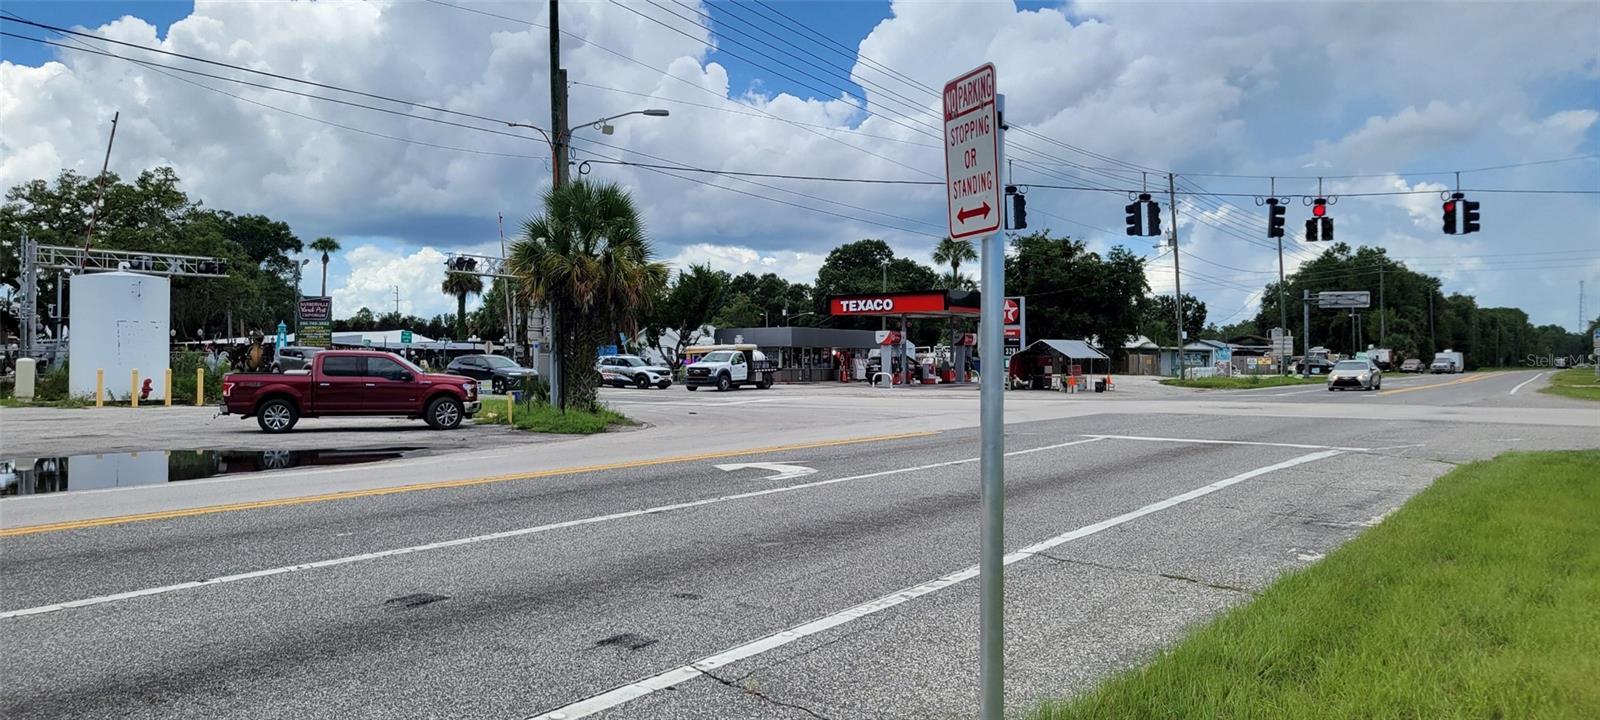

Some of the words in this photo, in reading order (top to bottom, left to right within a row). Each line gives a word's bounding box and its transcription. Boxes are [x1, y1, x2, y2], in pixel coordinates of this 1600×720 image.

[946, 89, 956, 113] NO
[957, 73, 992, 110] PARKING
[951, 115, 990, 147] STOPPING
[964, 148, 977, 169] OR
[953, 171, 992, 200] STANDING
[840, 299, 893, 312] TEXACO
